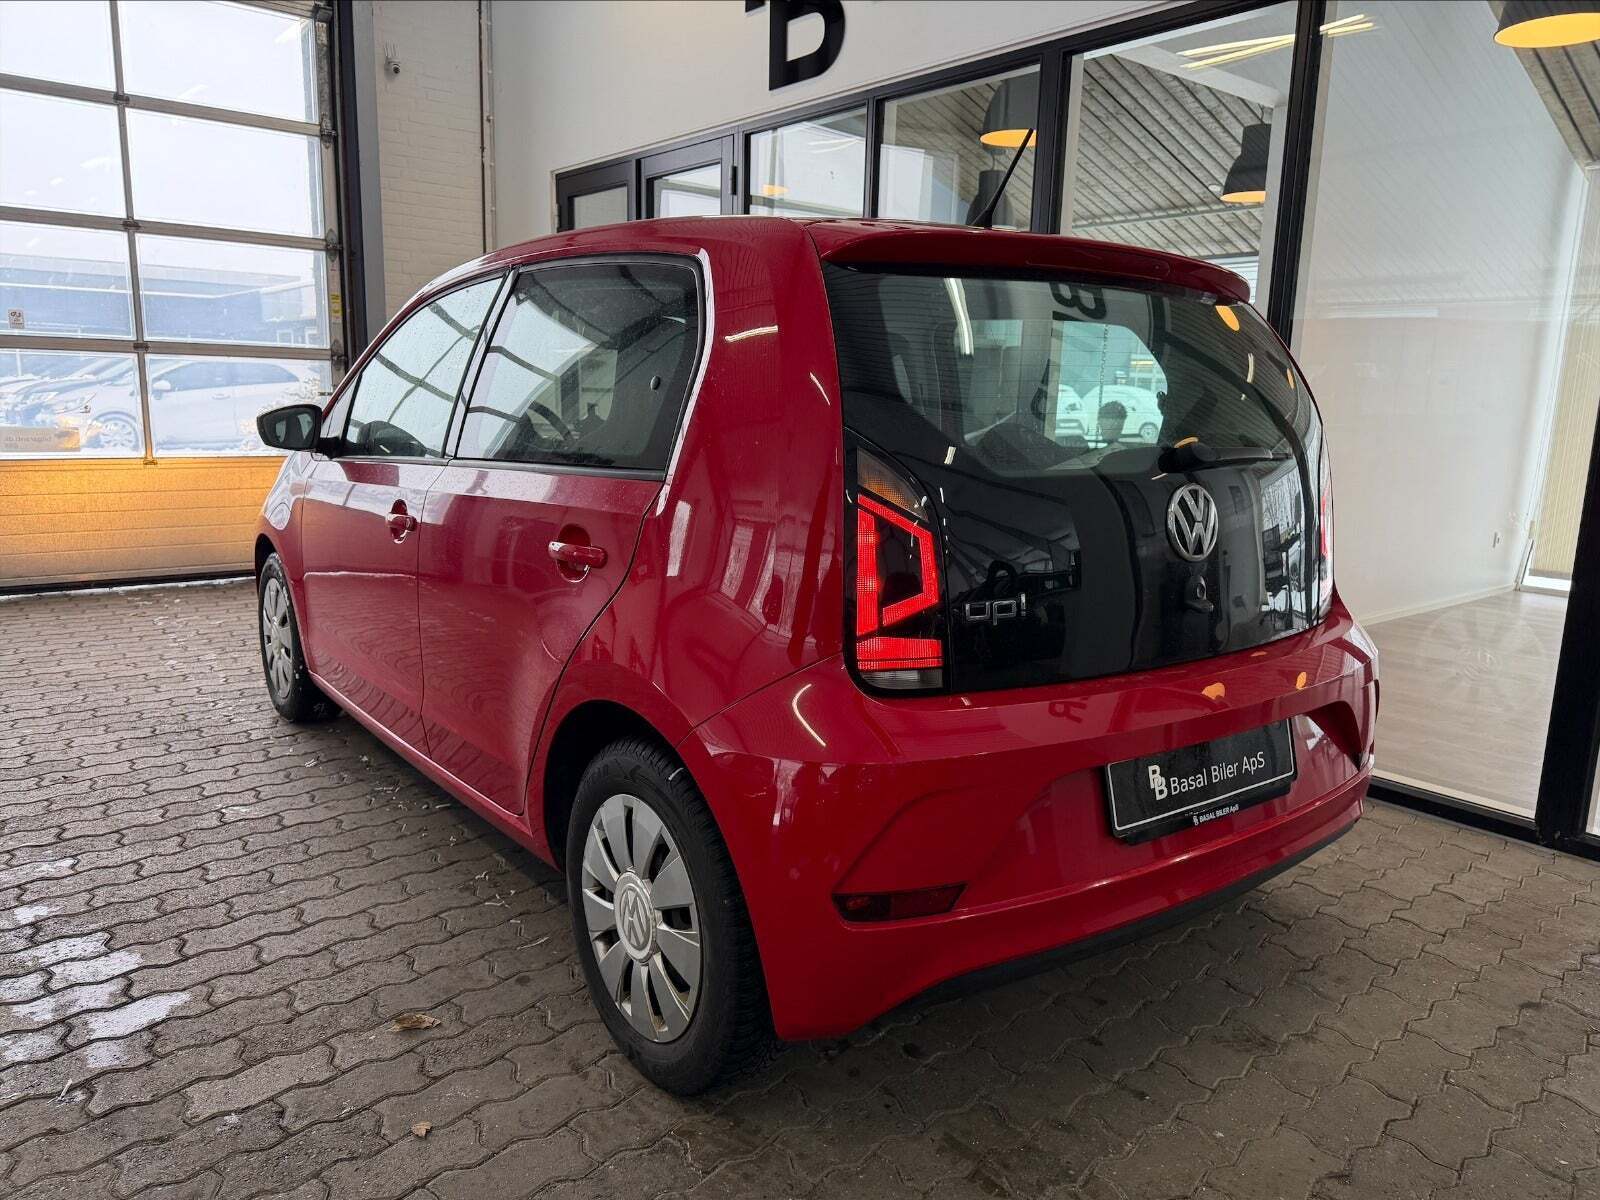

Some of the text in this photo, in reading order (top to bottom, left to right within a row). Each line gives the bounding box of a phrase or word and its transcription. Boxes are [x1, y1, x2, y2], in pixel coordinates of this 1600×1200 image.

[965, 593, 1026, 625] up!
[1170, 768, 1208, 796] Basal
[1211, 761, 1239, 784] Biler
[1242, 751, 1265, 775] ApS
[1199, 812, 1216, 823] BASAL
